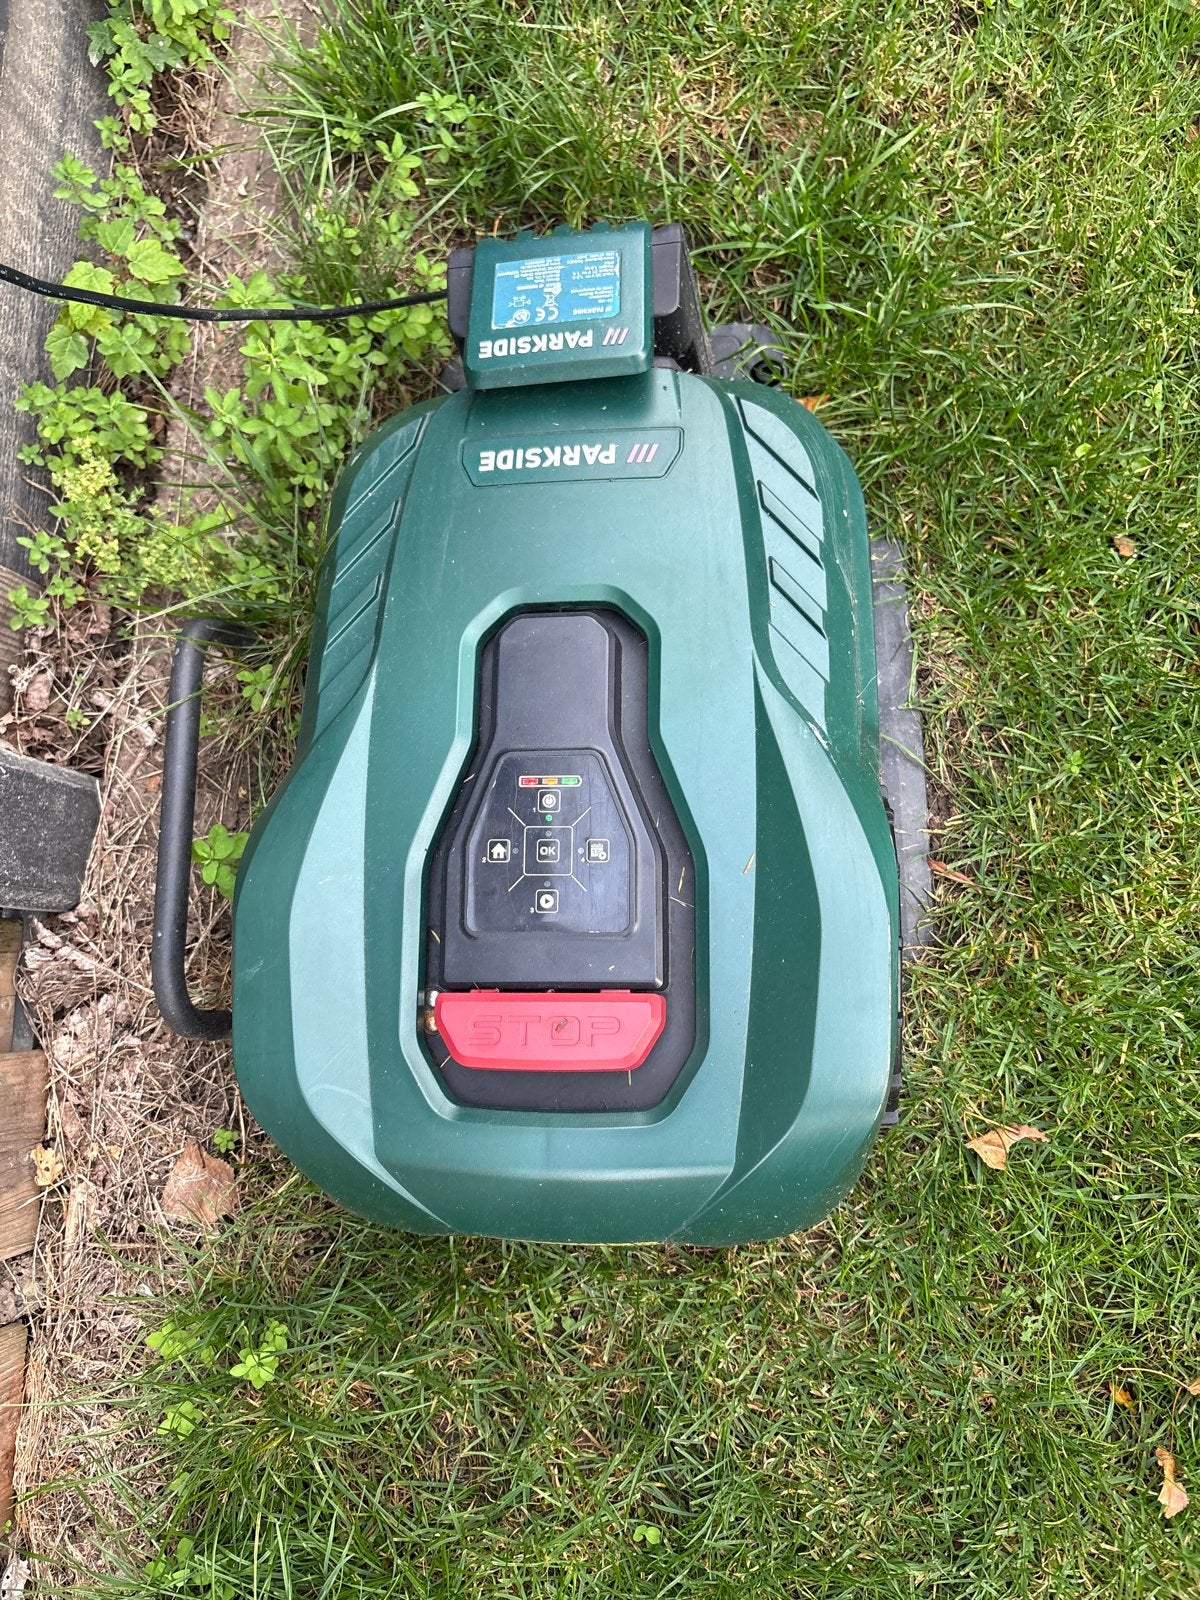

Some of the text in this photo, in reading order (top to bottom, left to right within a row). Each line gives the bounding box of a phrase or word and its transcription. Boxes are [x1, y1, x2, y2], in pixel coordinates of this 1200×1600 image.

[478, 329, 594, 359] PARKSIDE
[478, 443, 618, 472] PARKSIDE
[540, 846, 556, 856] OK
[467, 1014, 621, 1047] STOP
